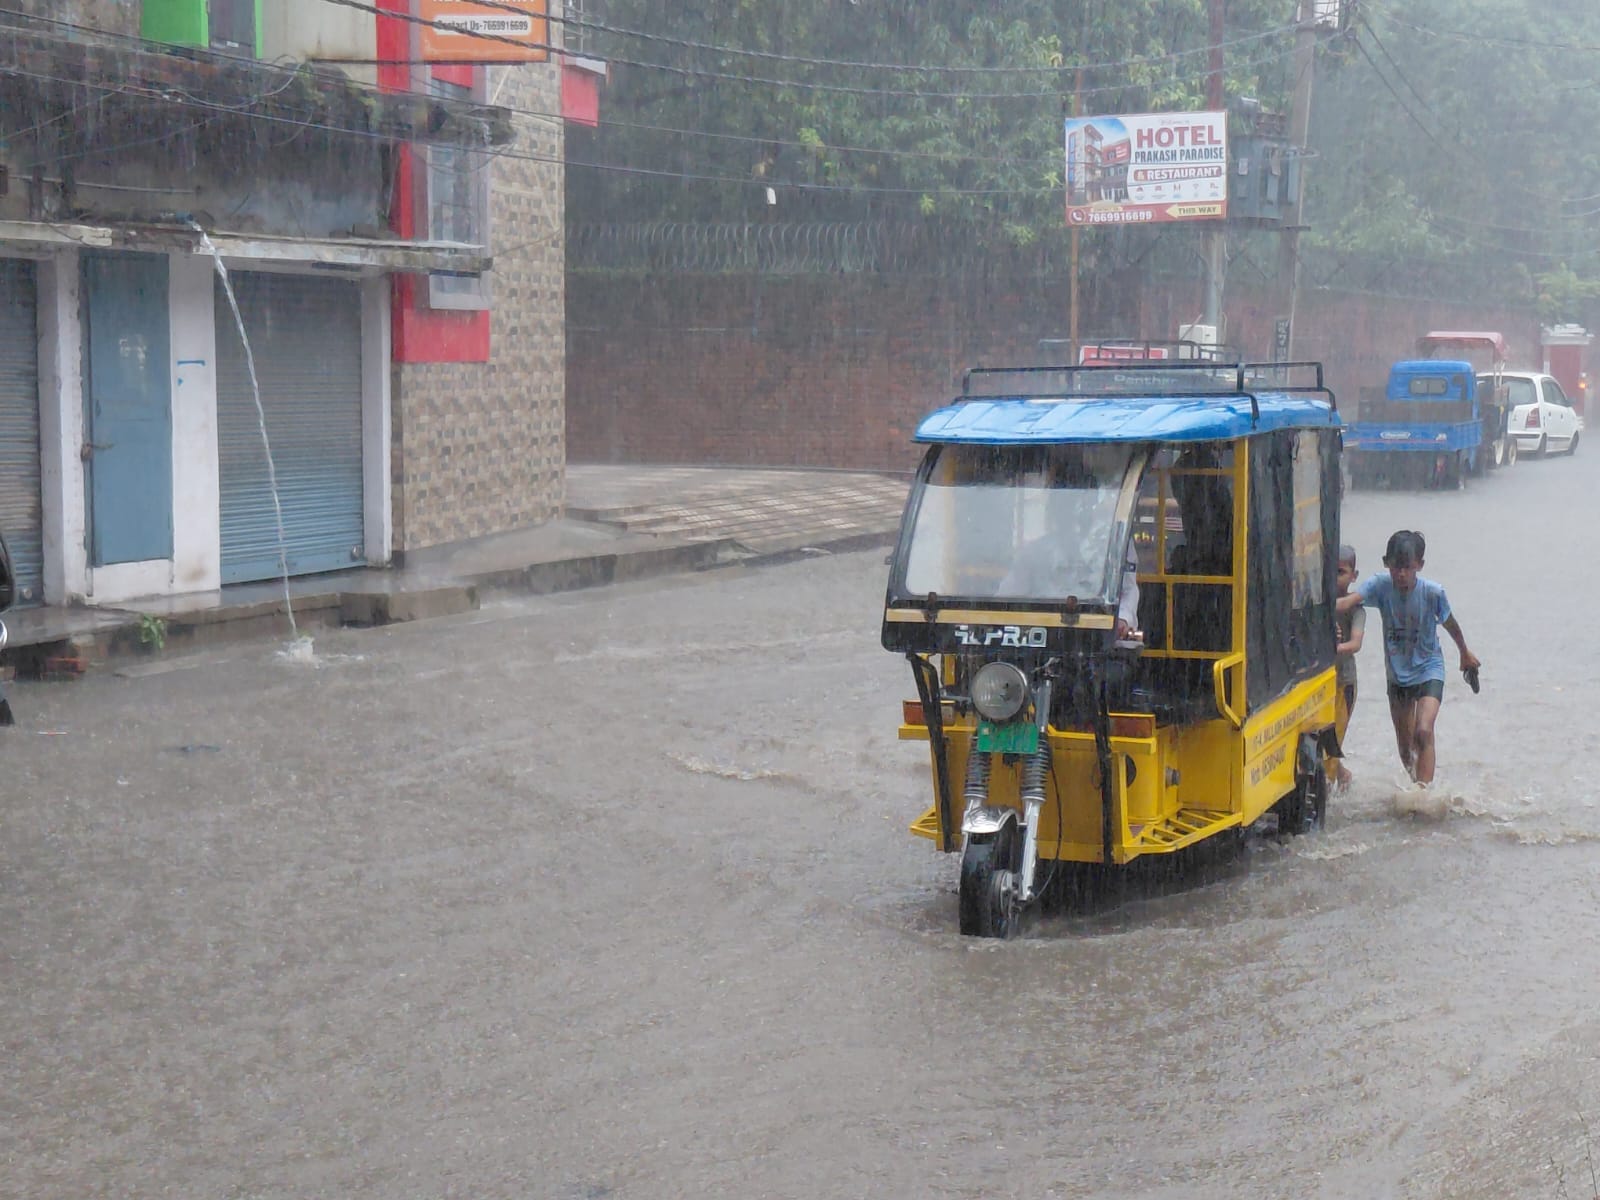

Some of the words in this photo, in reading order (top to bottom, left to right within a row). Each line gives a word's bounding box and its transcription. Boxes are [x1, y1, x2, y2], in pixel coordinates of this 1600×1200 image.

[1136, 125, 1222, 149] HOTEL
[1135, 149, 1177, 162] PRAKASH
[1179, 147, 1224, 161] PARADISE
[1147, 167, 1218, 180] RESTAURANT
